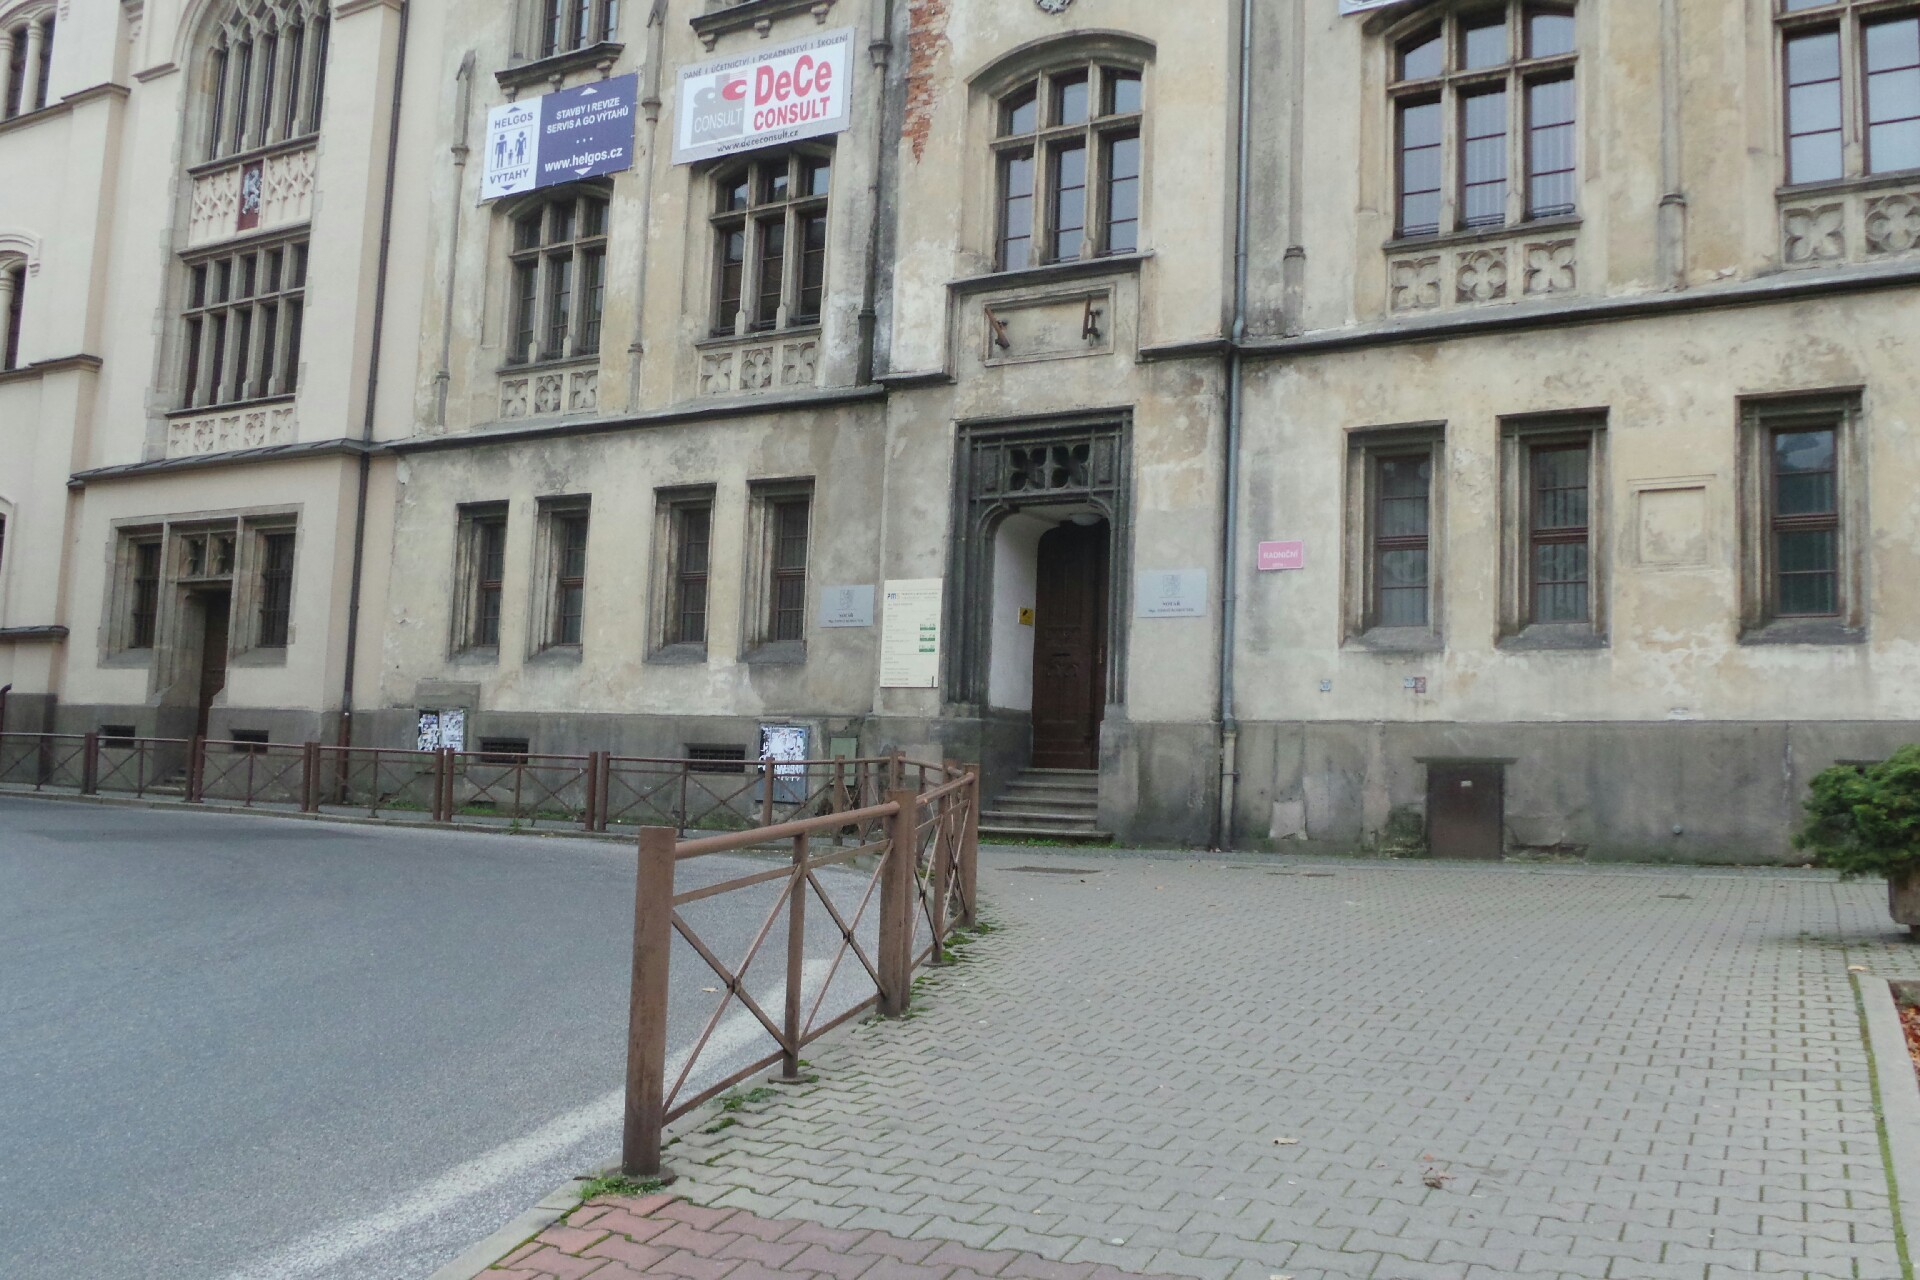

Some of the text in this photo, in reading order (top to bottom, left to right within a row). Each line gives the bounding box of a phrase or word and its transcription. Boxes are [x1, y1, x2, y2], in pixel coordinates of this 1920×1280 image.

[758, 43, 808, 62] PORADENSTVÍ
[817, 32, 849, 49] ŠKOLENÍ
[754, 54, 832, 107] DeCe
[494, 112, 534, 129] HELGOS
[546, 105, 629, 134] SERVIS A GO VÝTAHŮ
[556, 104, 586, 120] STAVBY
[591, 97, 620, 111] REVIZE
[694, 107, 743, 134] CONSULT
[753, 96, 831, 131] CONSULT
[717, 129, 799, 152] www.dececonsult.cz
[544, 147, 623, 172] www.helgos.cz
